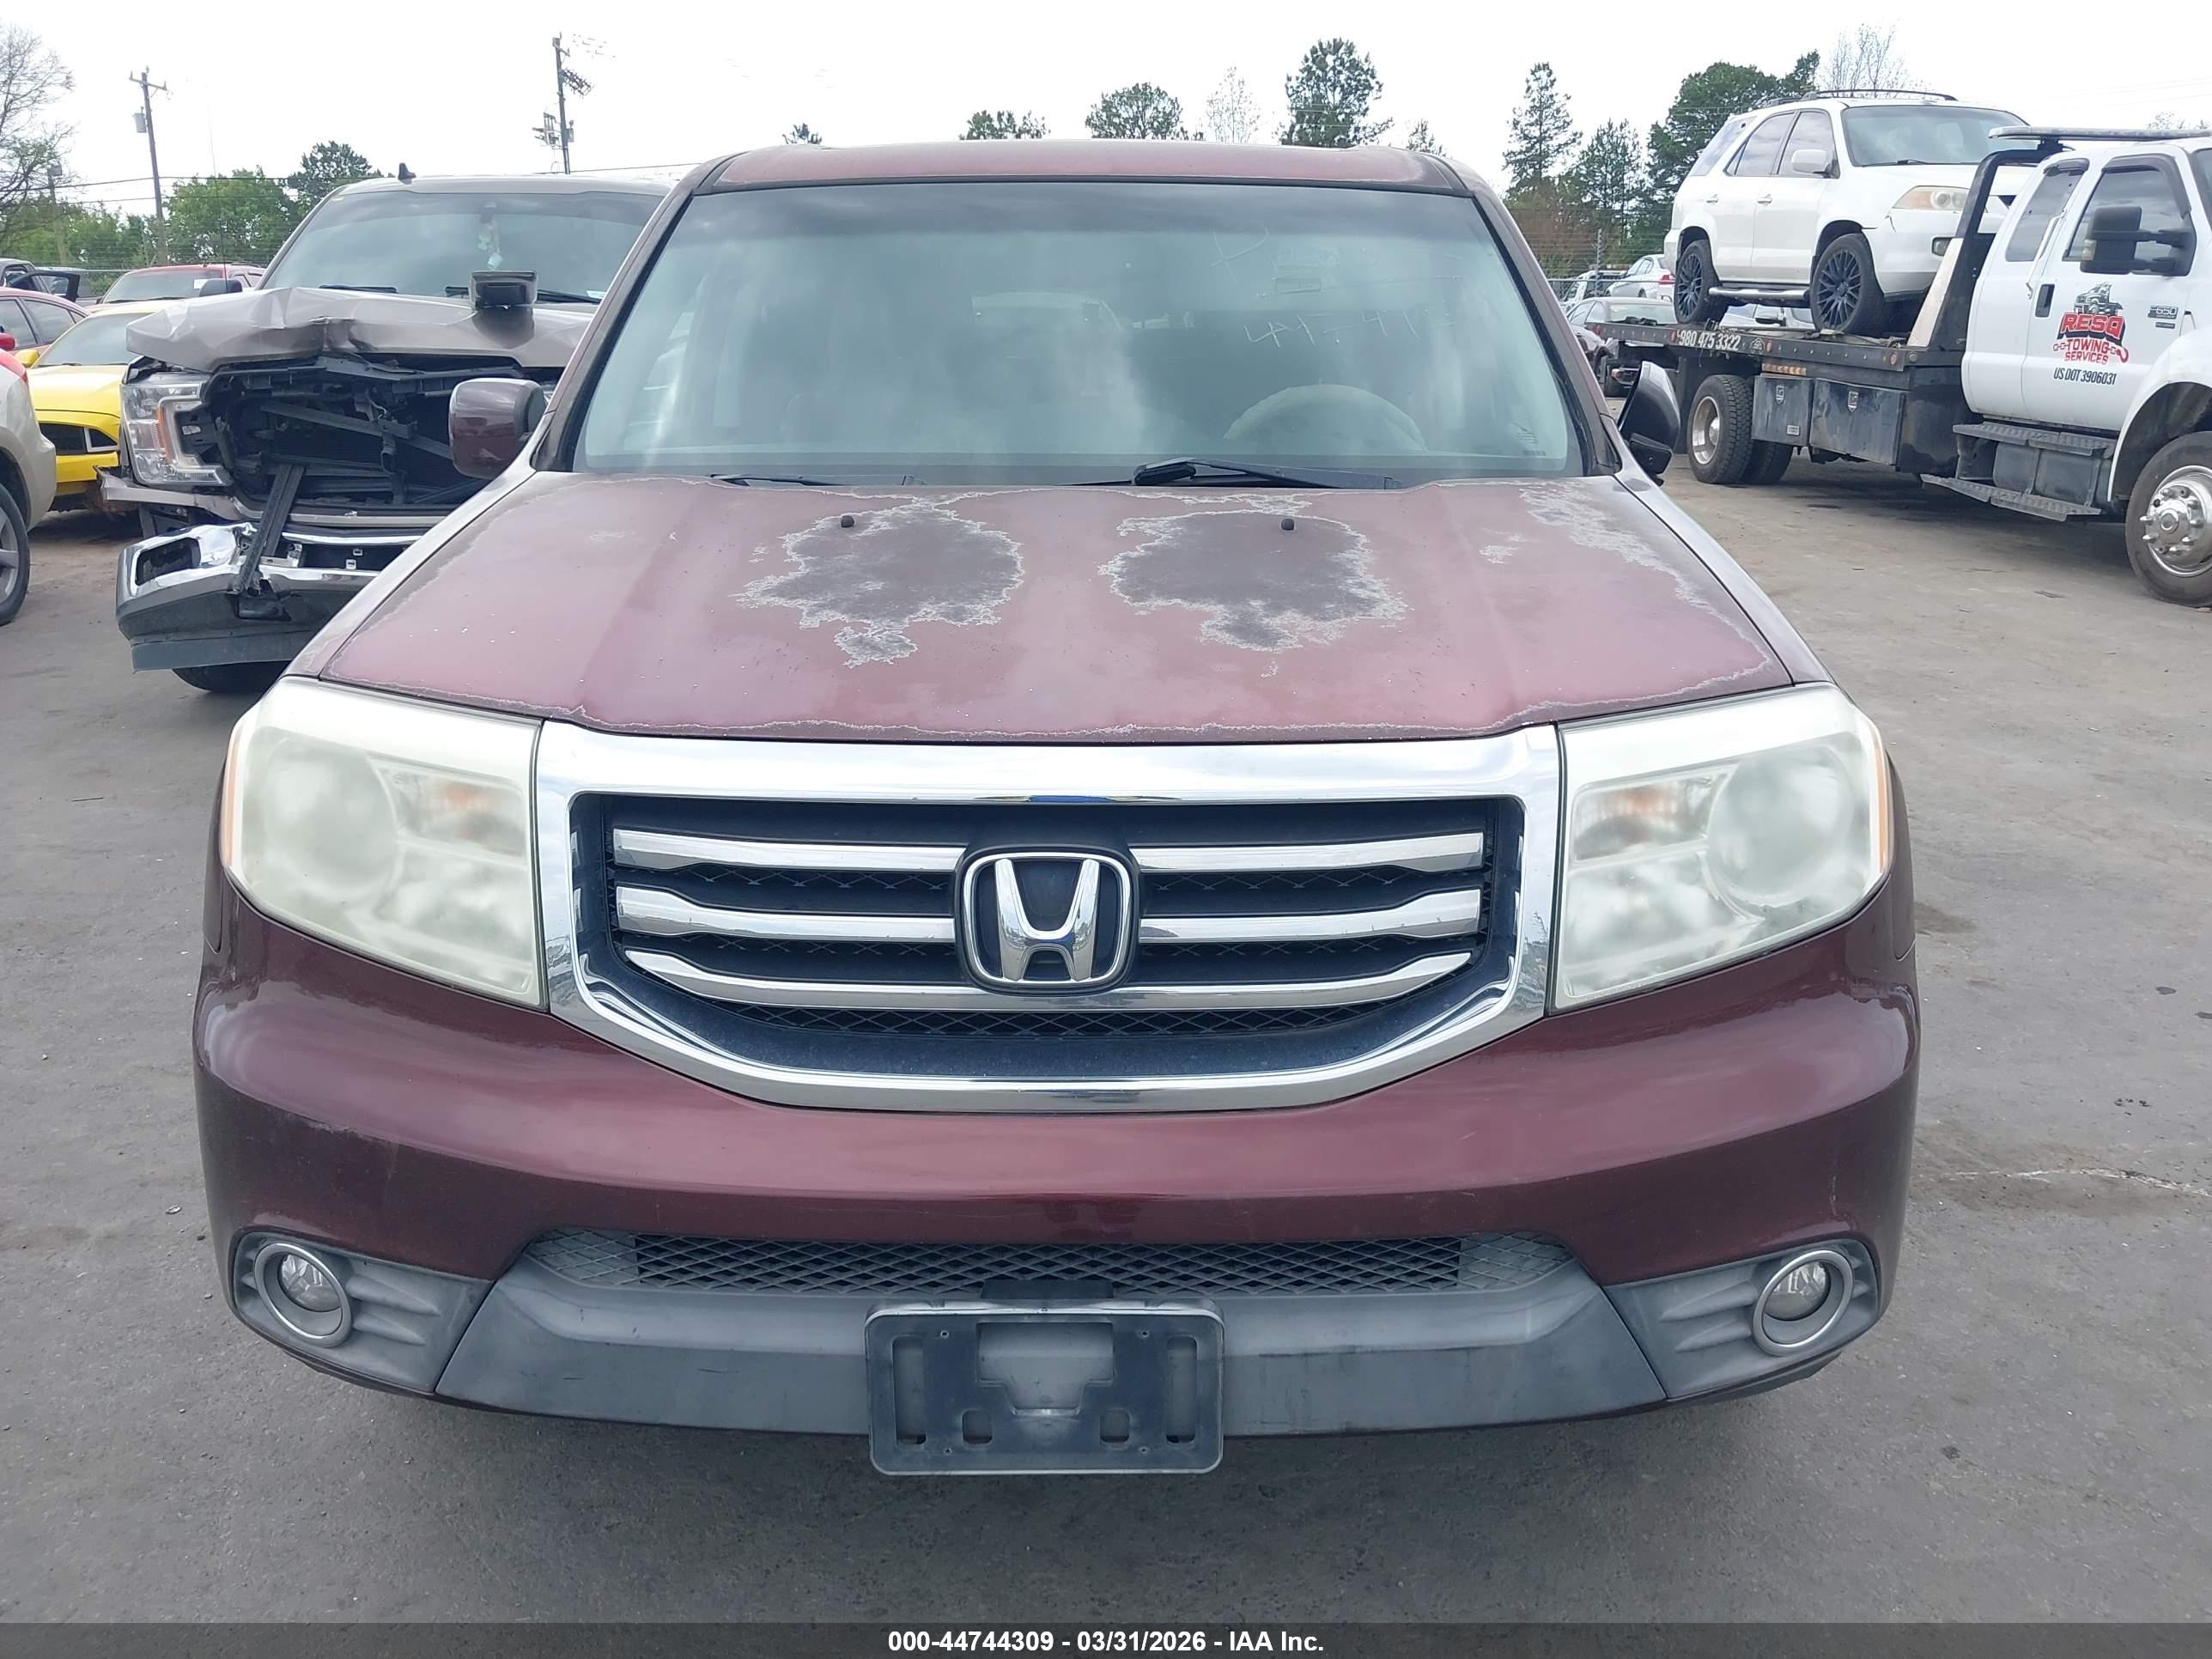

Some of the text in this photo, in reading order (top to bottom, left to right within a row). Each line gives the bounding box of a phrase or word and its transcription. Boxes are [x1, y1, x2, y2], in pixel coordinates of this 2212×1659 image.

[2060, 313, 2125, 343] RESQ
[1679, 330, 1741, 351] 980 475 3322
[2067, 338, 2110, 354] TOWING
[2064, 351, 2109, 365] SERVICES
[2053, 368, 2118, 385] US DOT 3906031
